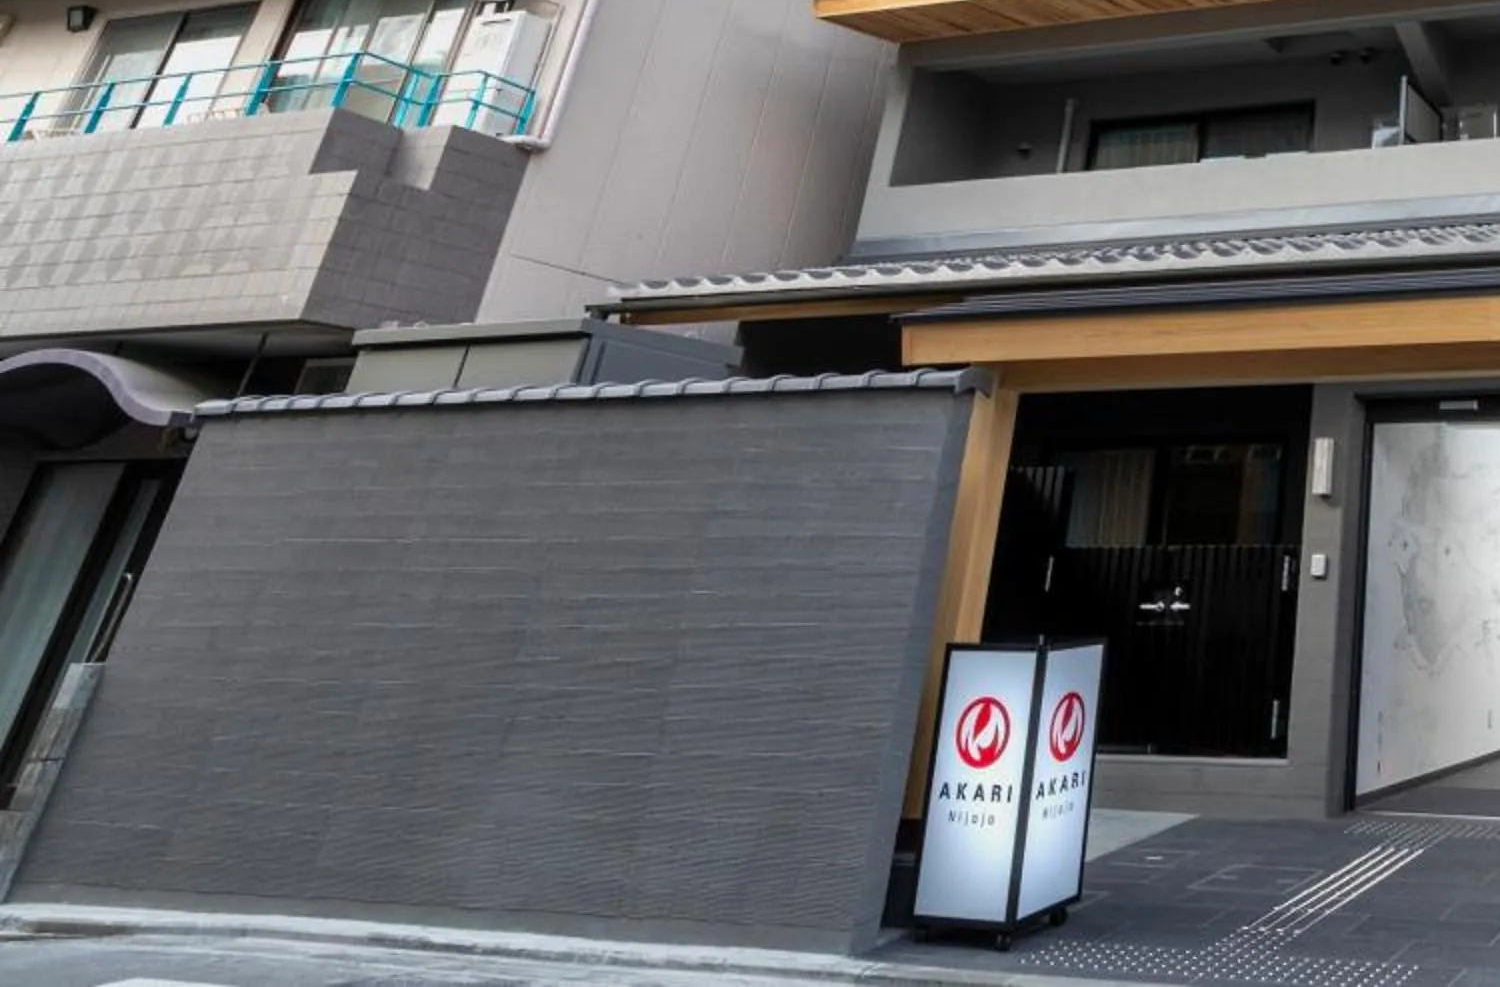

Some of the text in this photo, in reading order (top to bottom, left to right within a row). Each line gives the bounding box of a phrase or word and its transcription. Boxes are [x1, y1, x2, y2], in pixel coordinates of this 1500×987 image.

[939, 781, 1013, 803] AKARI
[1035, 771, 1086, 800] AKARI
[948, 809, 995, 827] Nijojo
